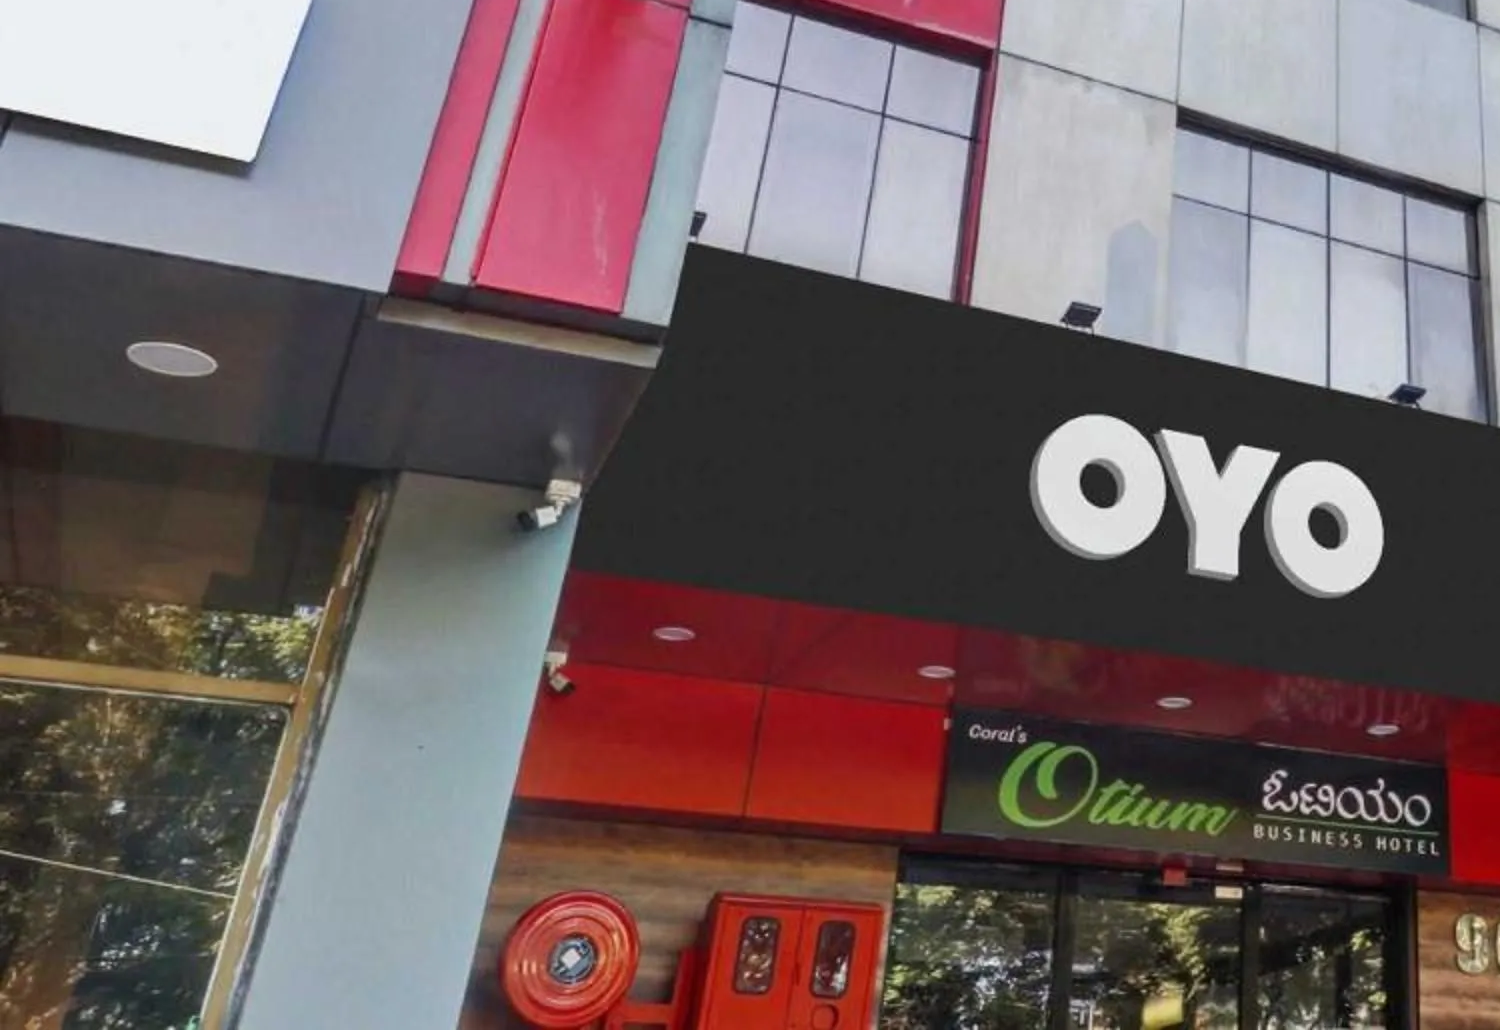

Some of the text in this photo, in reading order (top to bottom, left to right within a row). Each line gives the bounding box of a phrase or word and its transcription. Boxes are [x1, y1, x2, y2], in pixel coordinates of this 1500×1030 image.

[1030, 413, 1385, 599] OYO
[969, 723, 1028, 745] Coral's
[998, 741, 1240, 836] Otium
[1252, 823, 1441, 857] BUSINESS HOTEL
